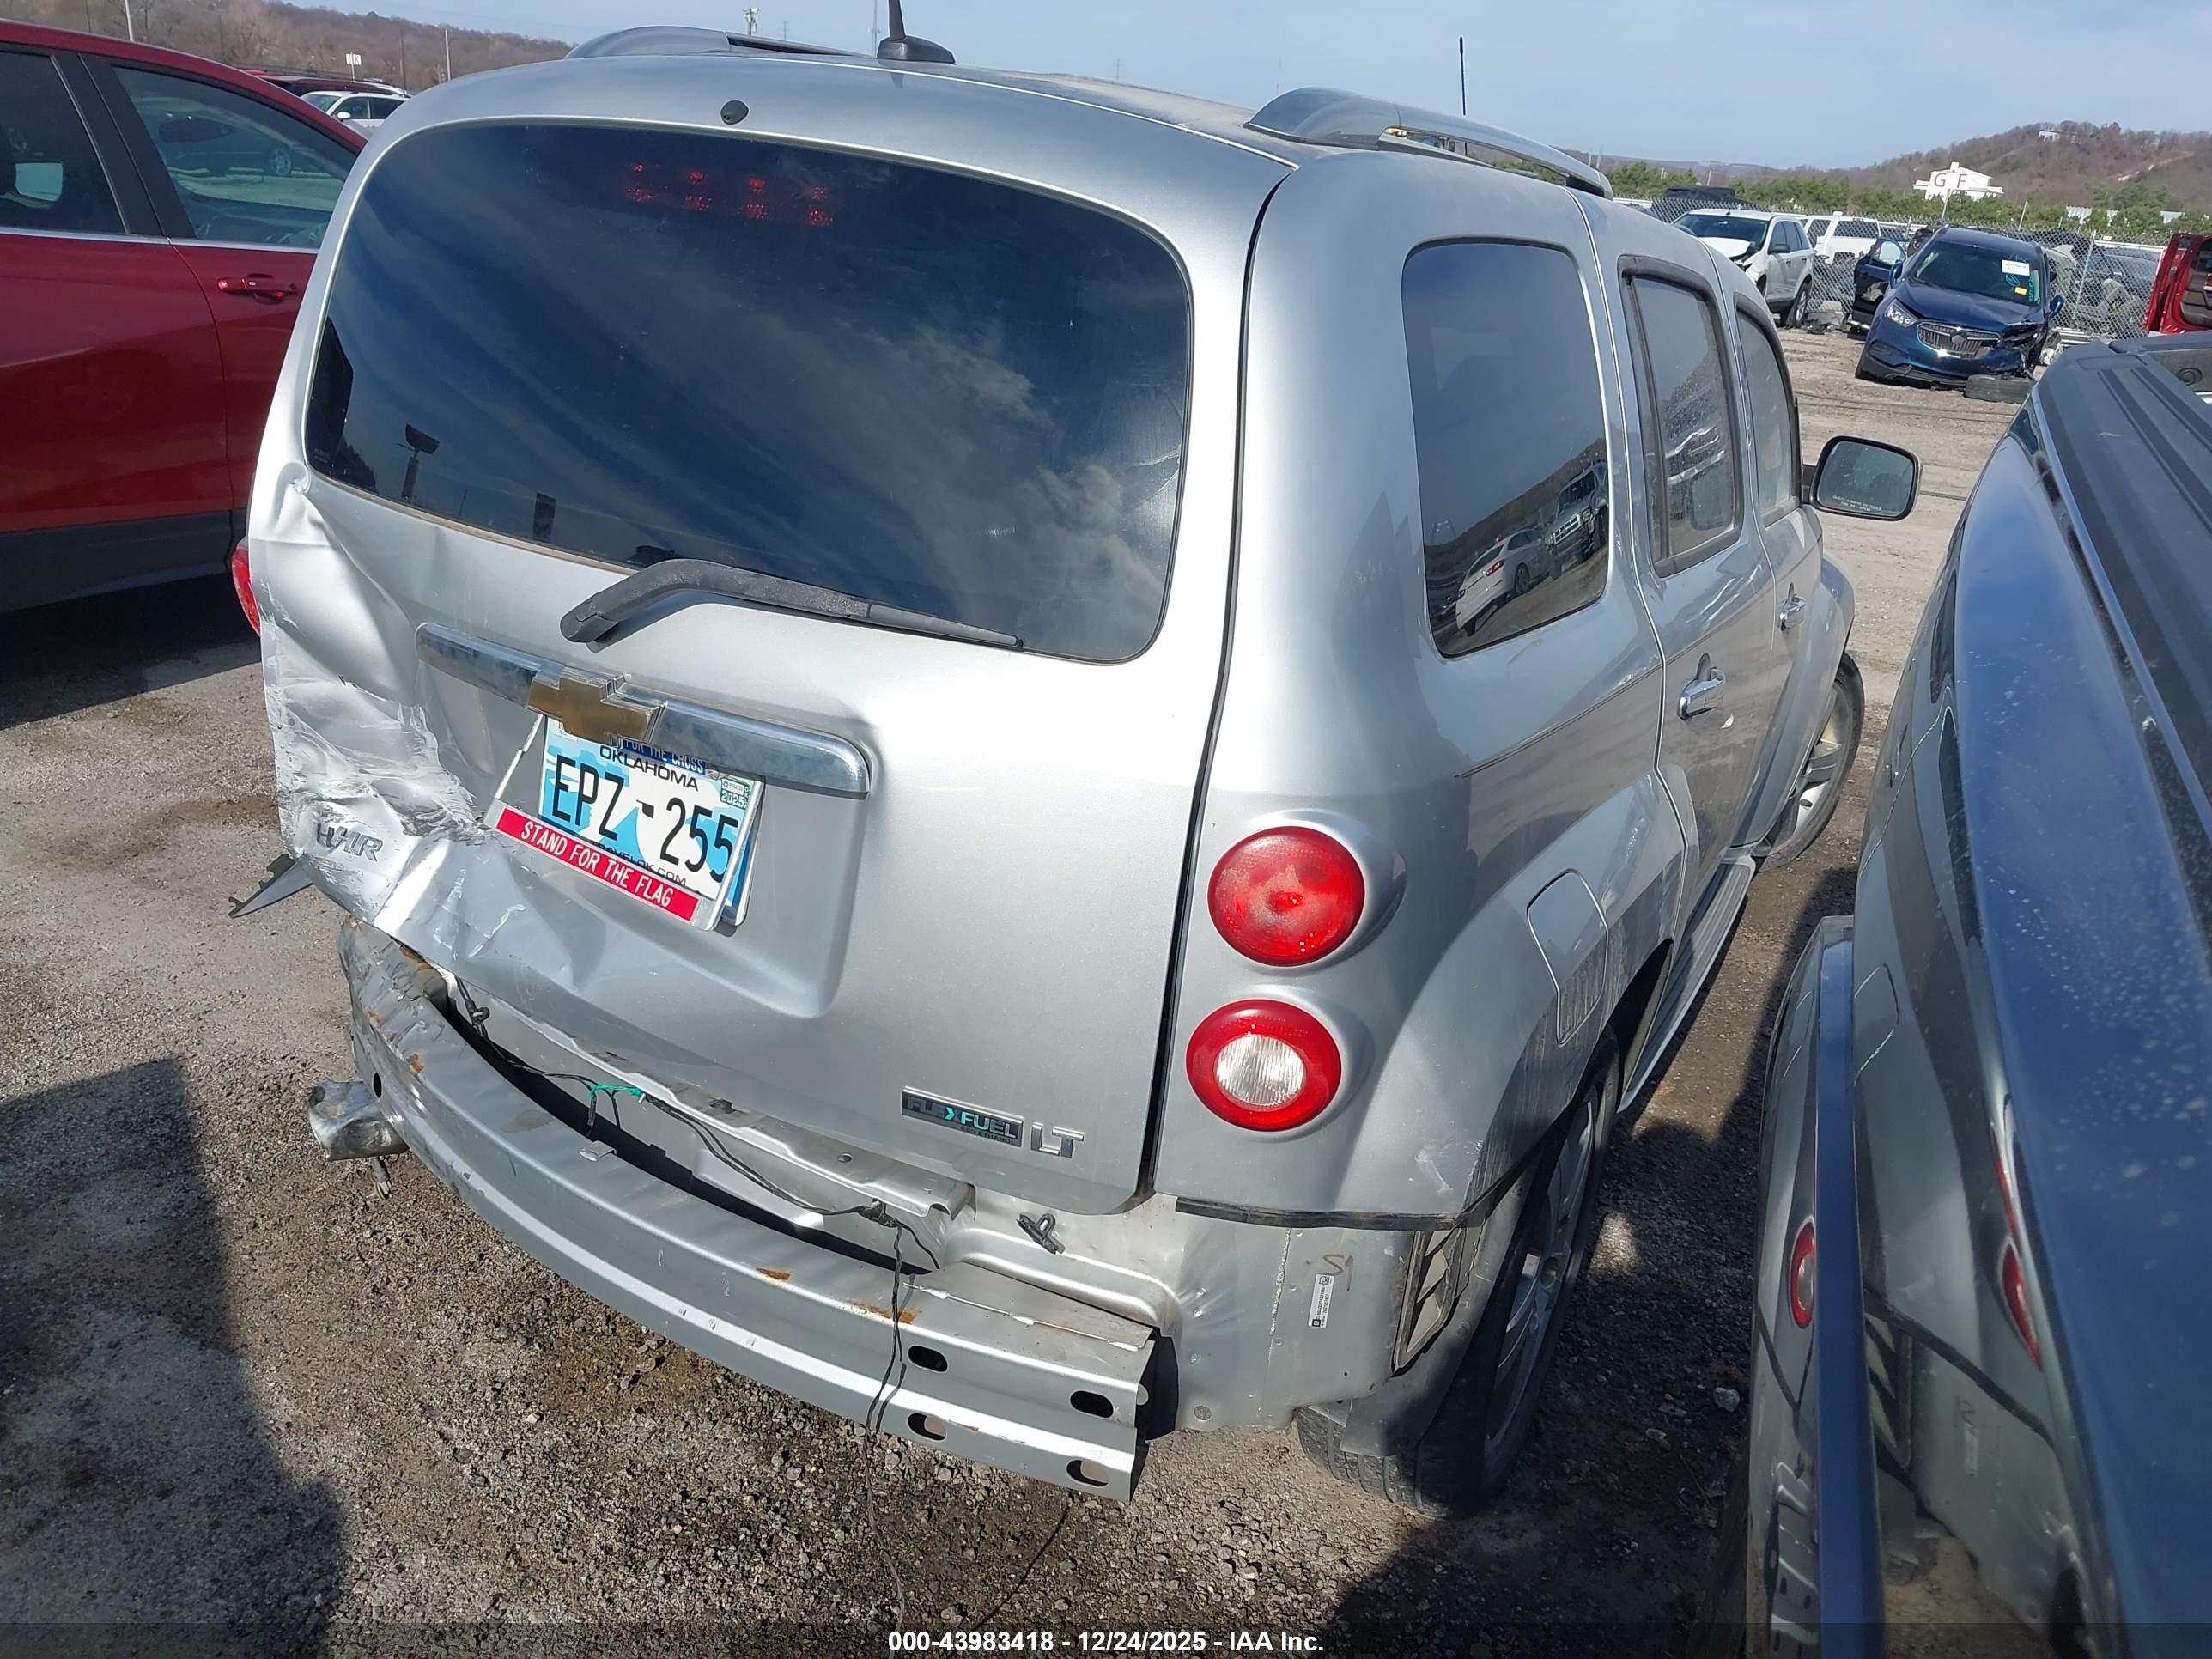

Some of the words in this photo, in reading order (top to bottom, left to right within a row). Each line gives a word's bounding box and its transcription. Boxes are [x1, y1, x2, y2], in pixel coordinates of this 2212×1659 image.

[599, 744, 699, 792] OKLAHOMA
[720, 789, 745, 808] 2025
[520, 820, 568, 856] STAND
[568, 843, 601, 872] FOR
[604, 859, 635, 889] THE
[635, 874, 674, 908] FLAG
[593, 842, 687, 886] TRAVELOKCOM
[1030, 1121, 1085, 1159] LT
